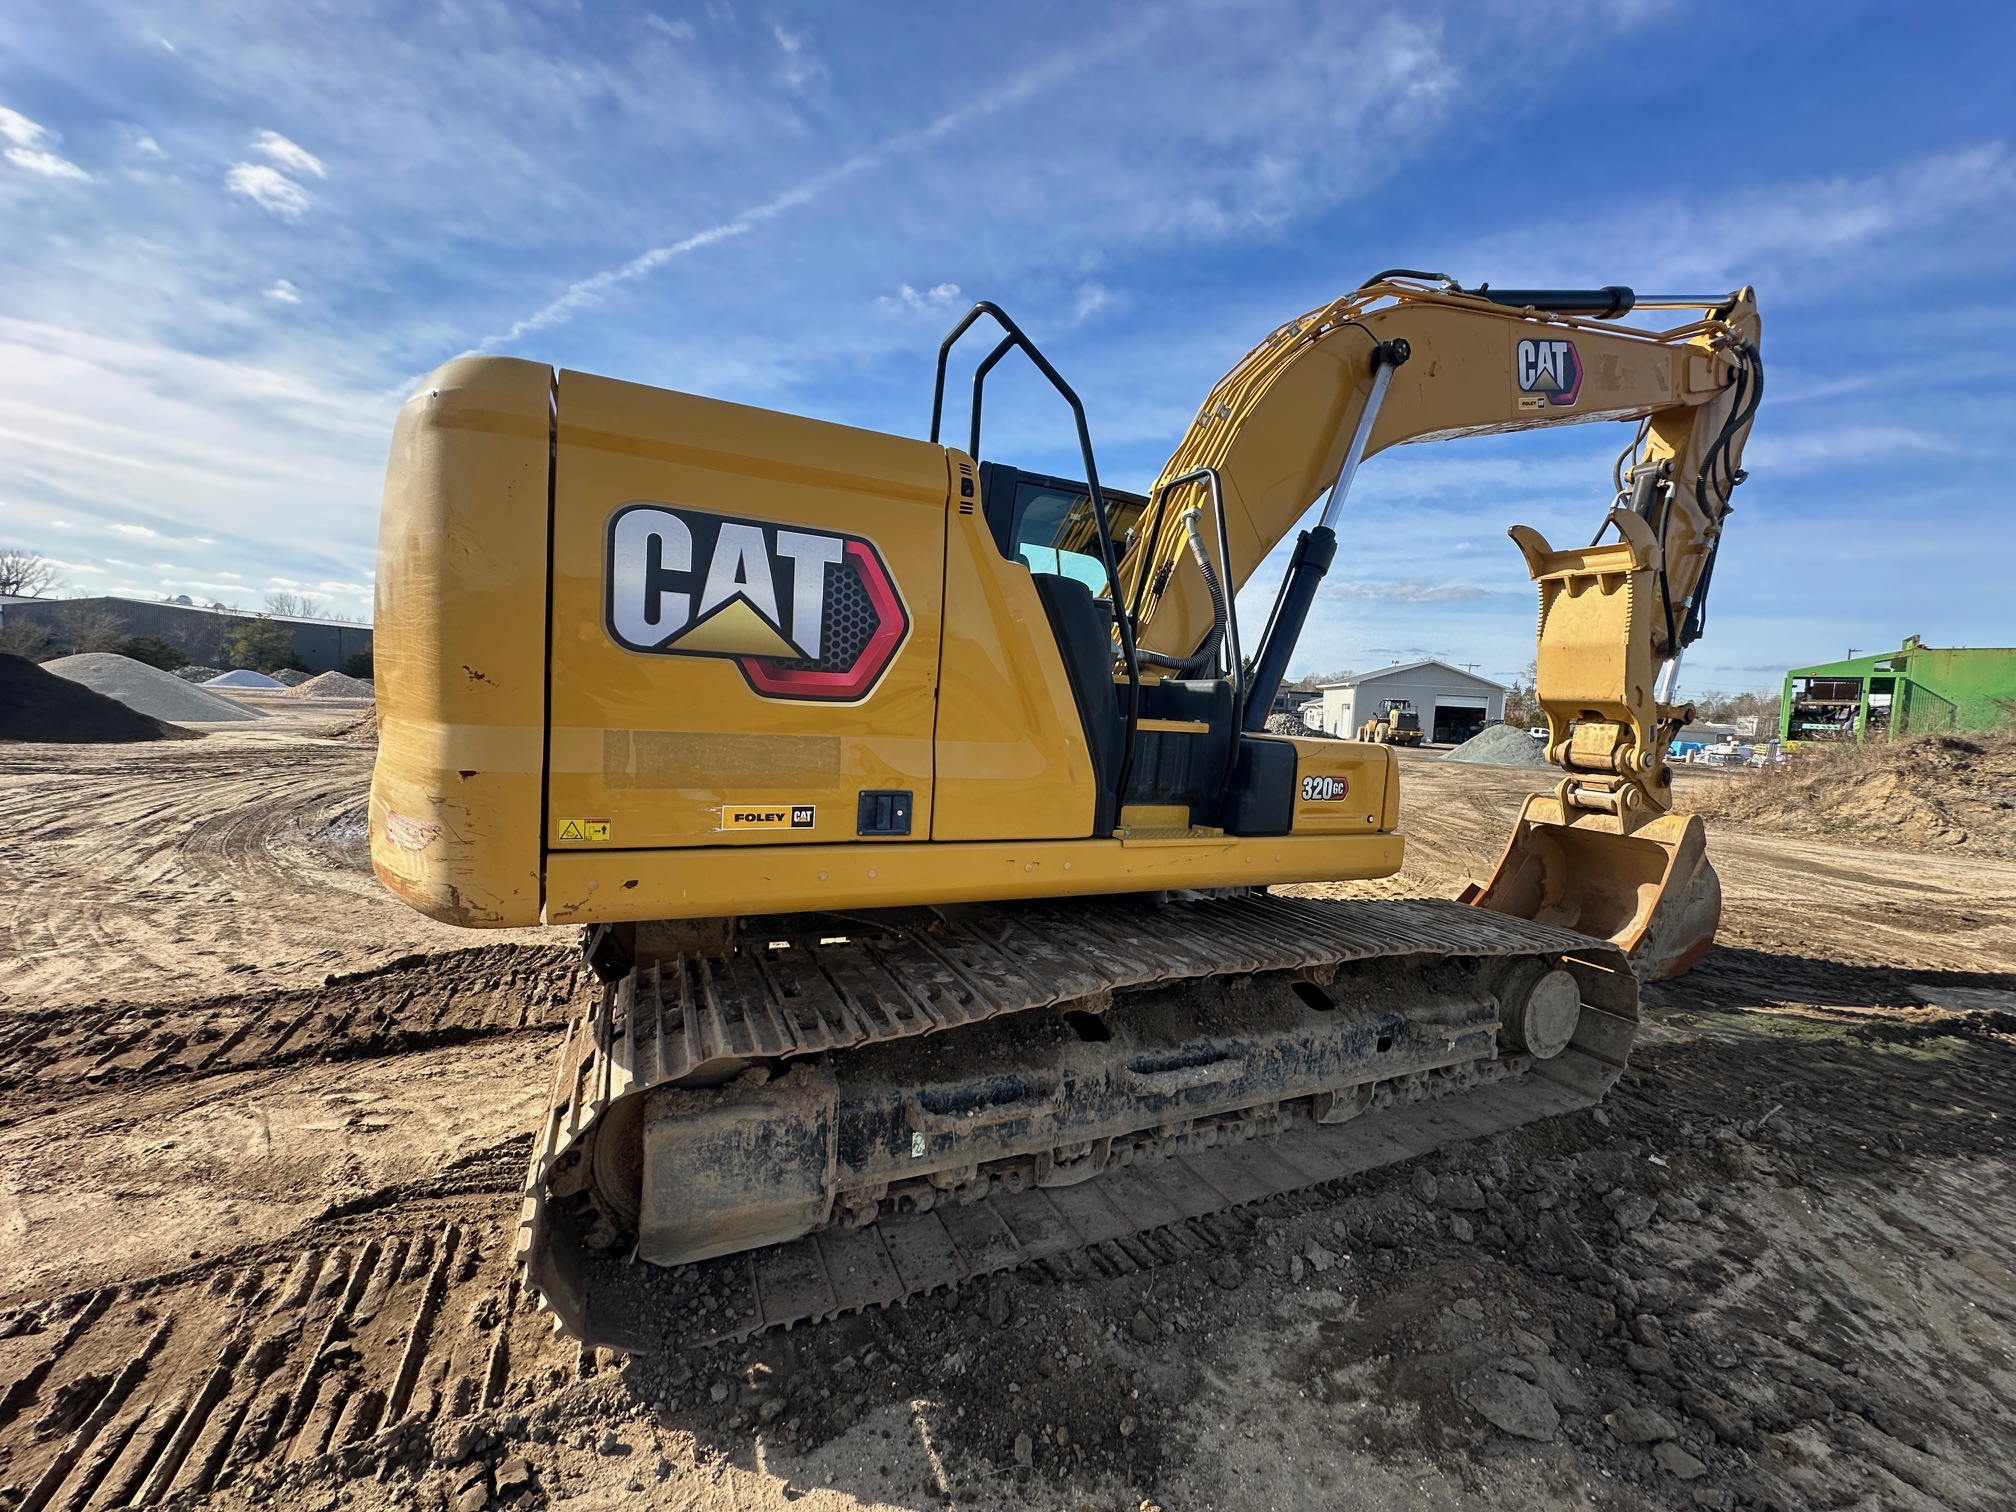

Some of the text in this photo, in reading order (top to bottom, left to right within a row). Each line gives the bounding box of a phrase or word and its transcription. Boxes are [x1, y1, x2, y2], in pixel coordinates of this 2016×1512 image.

[1518, 340, 1567, 390] CAT
[614, 509, 843, 660] CAT
[1302, 776, 1344, 800] 320 GC
[734, 811, 812, 823] FOLEY CAT
